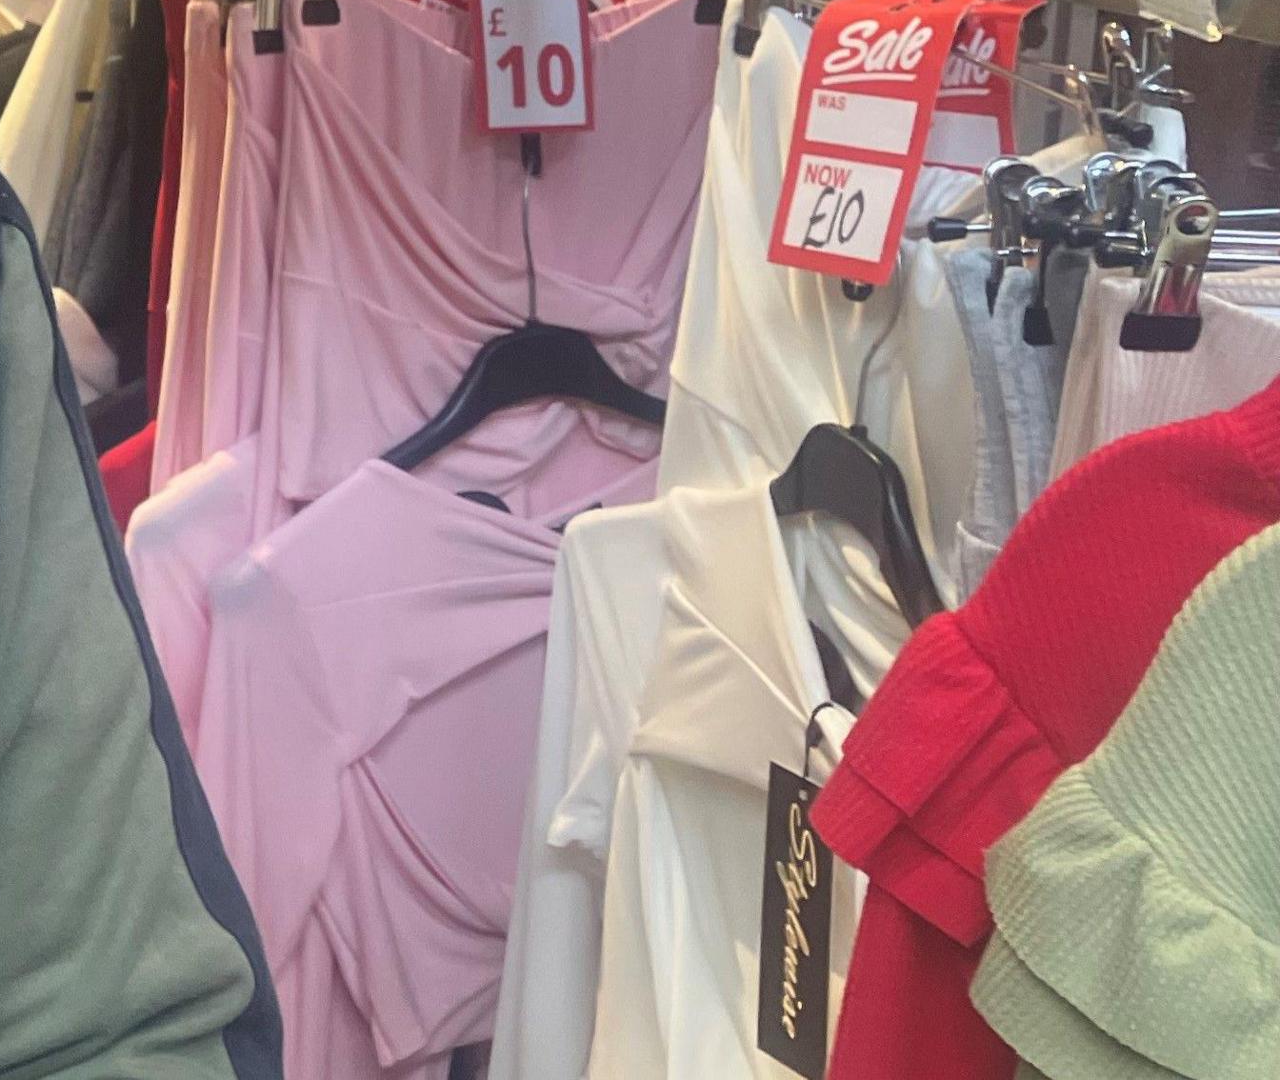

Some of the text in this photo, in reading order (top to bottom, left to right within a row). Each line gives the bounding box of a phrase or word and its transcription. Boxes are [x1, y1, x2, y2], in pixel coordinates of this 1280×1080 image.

[488, 6, 507, 38] £
[822, 15, 934, 75] Sale
[496, 42, 576, 108] 10
[942, 26, 997, 87] ale
[816, 94, 847, 112] WAS
[803, 162, 853, 188] NOW
[801, 185, 865, 250] £10
